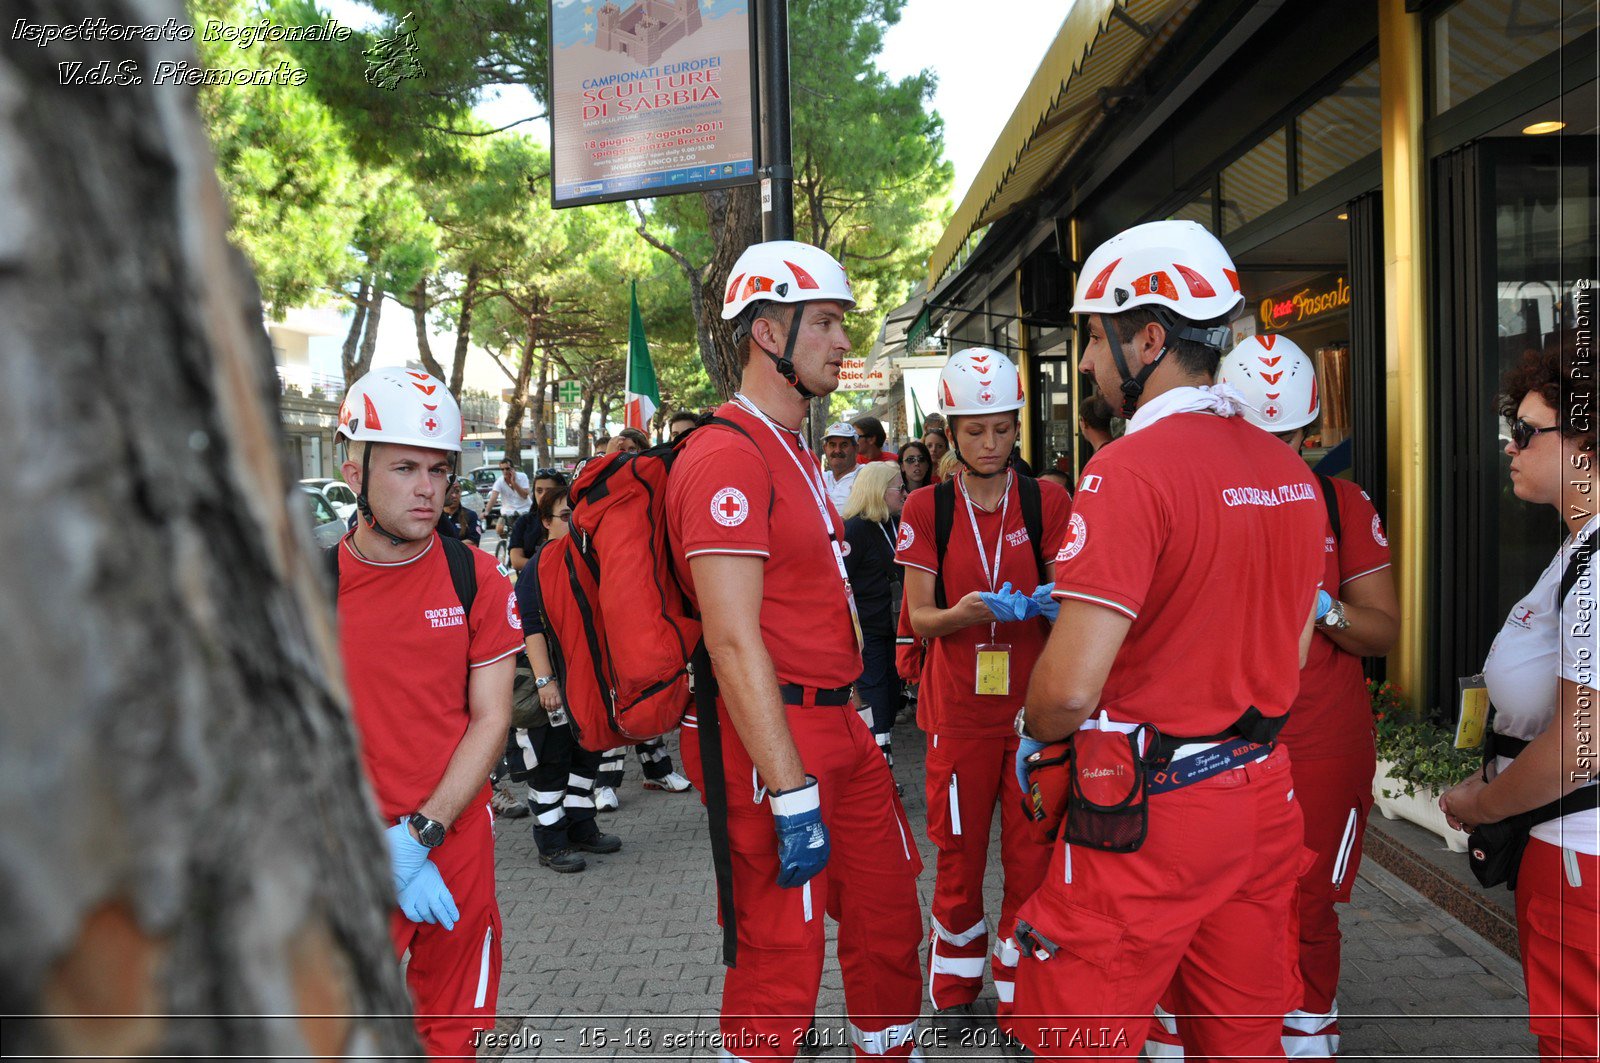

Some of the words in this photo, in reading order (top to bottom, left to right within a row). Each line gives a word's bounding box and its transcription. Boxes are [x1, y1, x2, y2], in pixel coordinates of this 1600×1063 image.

[582, 68, 659, 90] CAMPIONATI
[663, 56, 721, 76] EUROPEI
[583, 68, 721, 104] SCULTURE
[583, 103, 607, 120] DI
[617, 85, 720, 115] SABBIA
[584, 140, 596, 150] 18
[599, 136, 635, 150] giugno
[656, 126, 693, 140] agosto
[695, 121, 724, 133] 2011
[639, 140, 674, 154] piazza
[677, 134, 716, 146] Brescia
[611, 159, 647, 171] INGRESSO
[648, 157, 672, 166] UNICO
[680, 153, 696, 162] 2.00
[424, 608, 448, 619] CROCE
[431, 615, 464, 628] ITALIANA
[1232, 746, 1250, 757] RED
[1082, 768, 1115, 779] Holster
